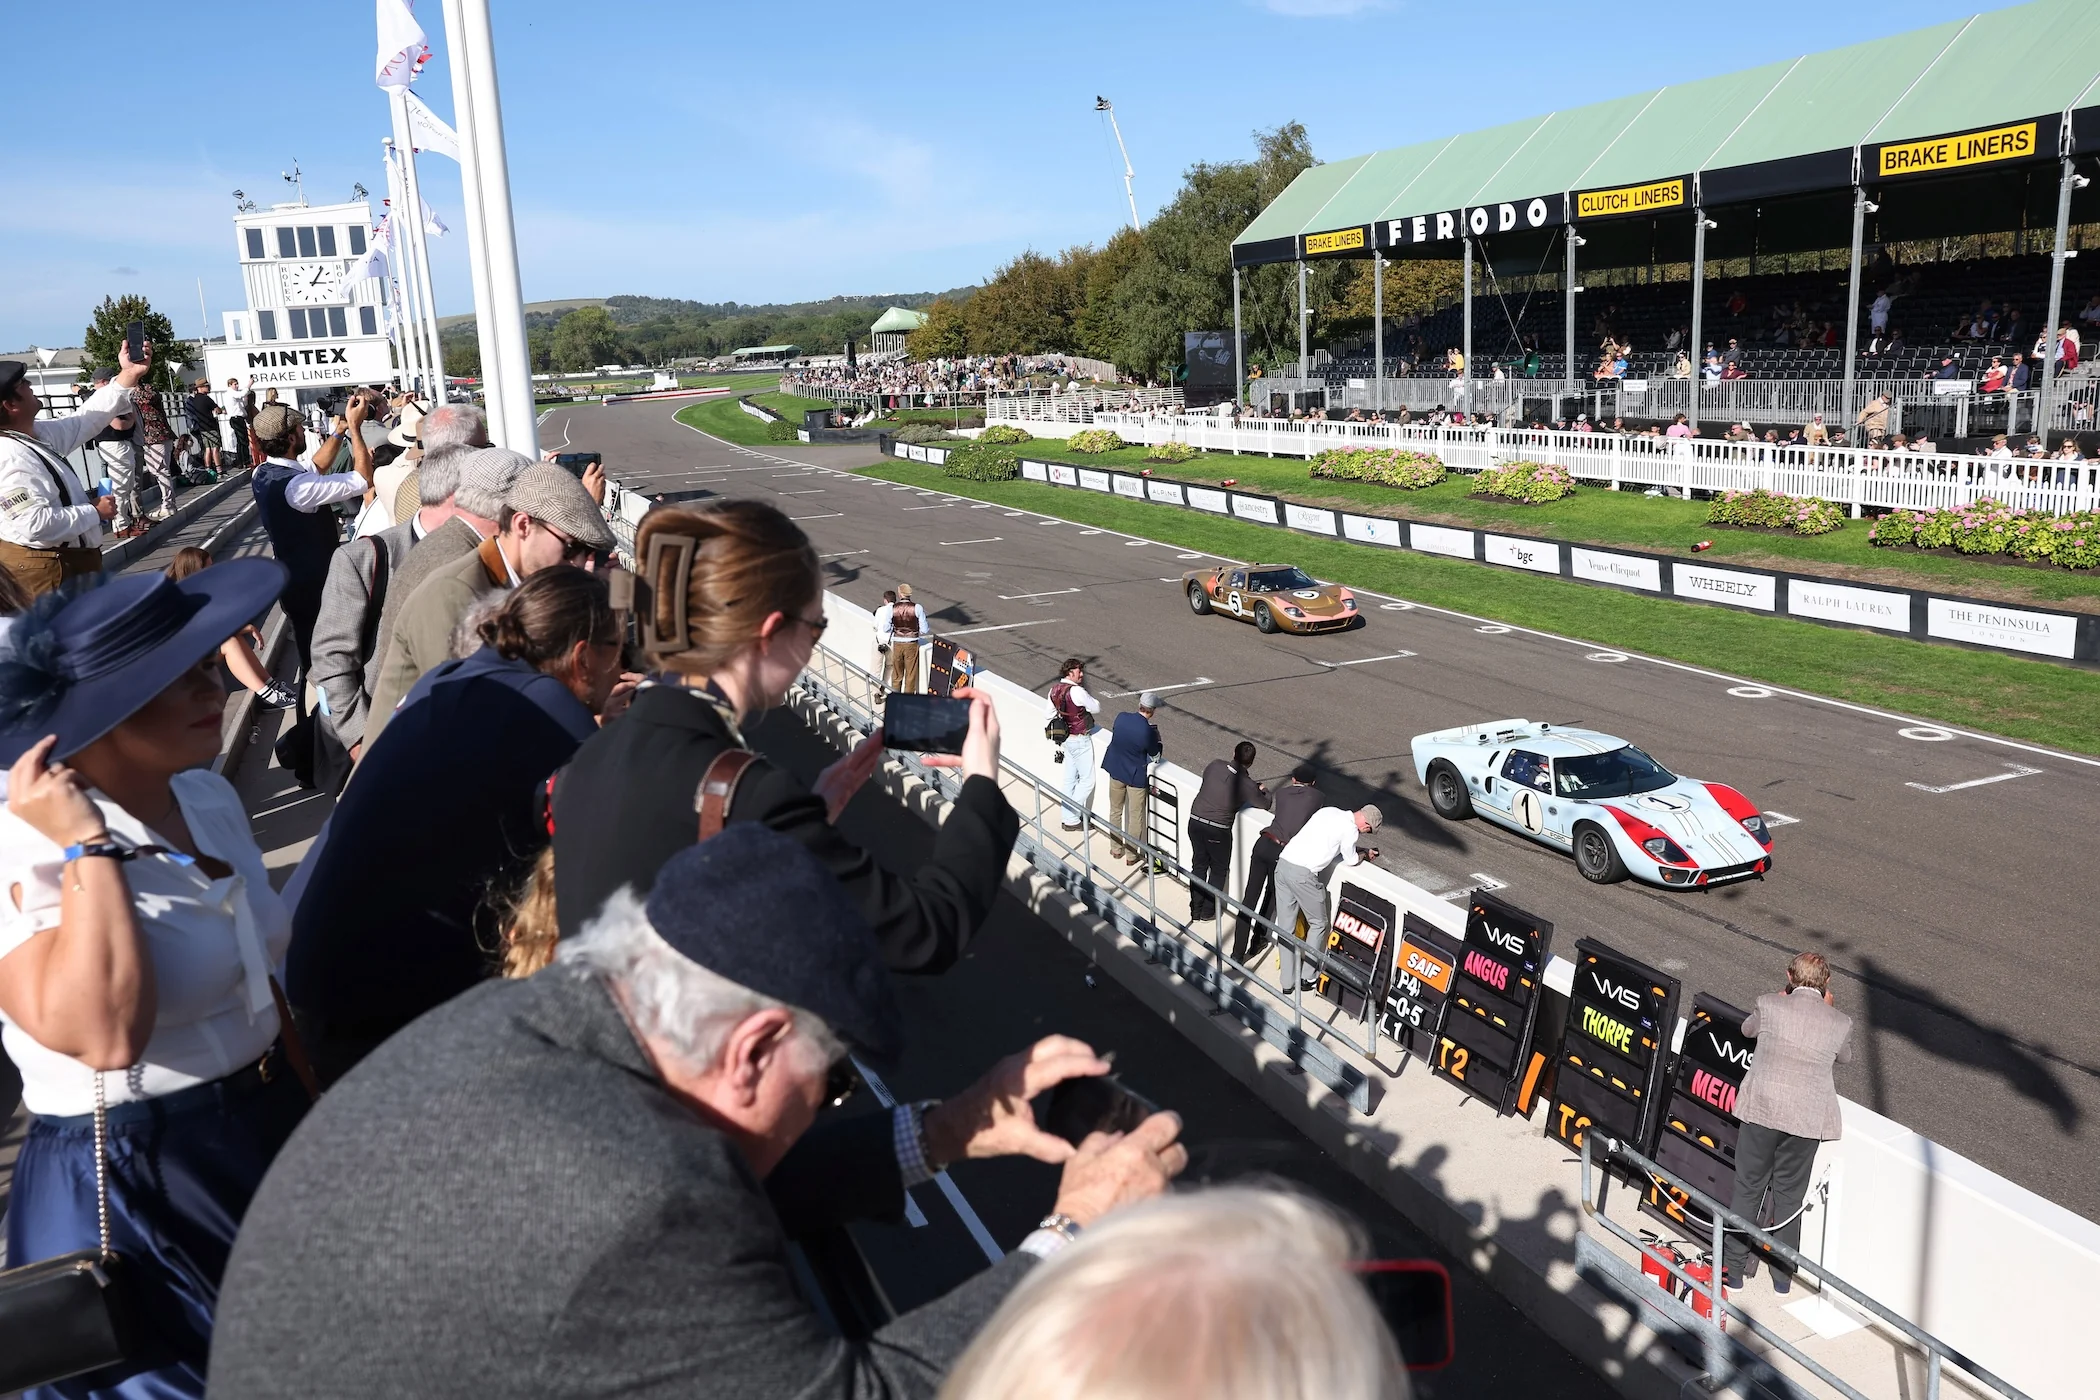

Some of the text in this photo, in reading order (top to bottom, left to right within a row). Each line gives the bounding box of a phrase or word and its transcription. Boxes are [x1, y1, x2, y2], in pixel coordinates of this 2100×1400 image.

[1885, 130, 2029, 170] BRAKE LINERS
[1581, 185, 1679, 212] CLUTCH LINERS
[1388, 198, 1548, 247] FERODO
[1307, 230, 1363, 251] BRAKE LINERS
[281, 266, 292, 302] ROLEX
[247, 347, 348, 368] MINTEX
[251, 367, 351, 384] BRAKE LINERS
[1152, 489, 1178, 498] ALPINE
[1297, 511, 1320, 524] Regent
[1517, 549, 1533, 565] bgc
[1588, 559, 1641, 578] Veuve Clicquot
[1689, 576, 1757, 597] WHEELY
[1231, 594, 1239, 613] 5
[1803, 594, 1893, 616] RALPH LAUREN
[1949, 609, 2051, 633] THE PENINSULA
[1971, 629, 2026, 643] LONDON
[1521, 793, 1535, 832] 1
[1647, 796, 1683, 810] 1
[1550, 832, 1566, 843] FORD
[1334, 911, 1380, 947] HOLME
[1327, 931, 1340, 950] P
[1406, 951, 1442, 979] SAIF
[1463, 950, 1509, 991] ANGUS
[1318, 973, 1330, 993] T
[1582, 1005, 1635, 1054] THORPE
[1440, 1036, 1470, 1081] T2
